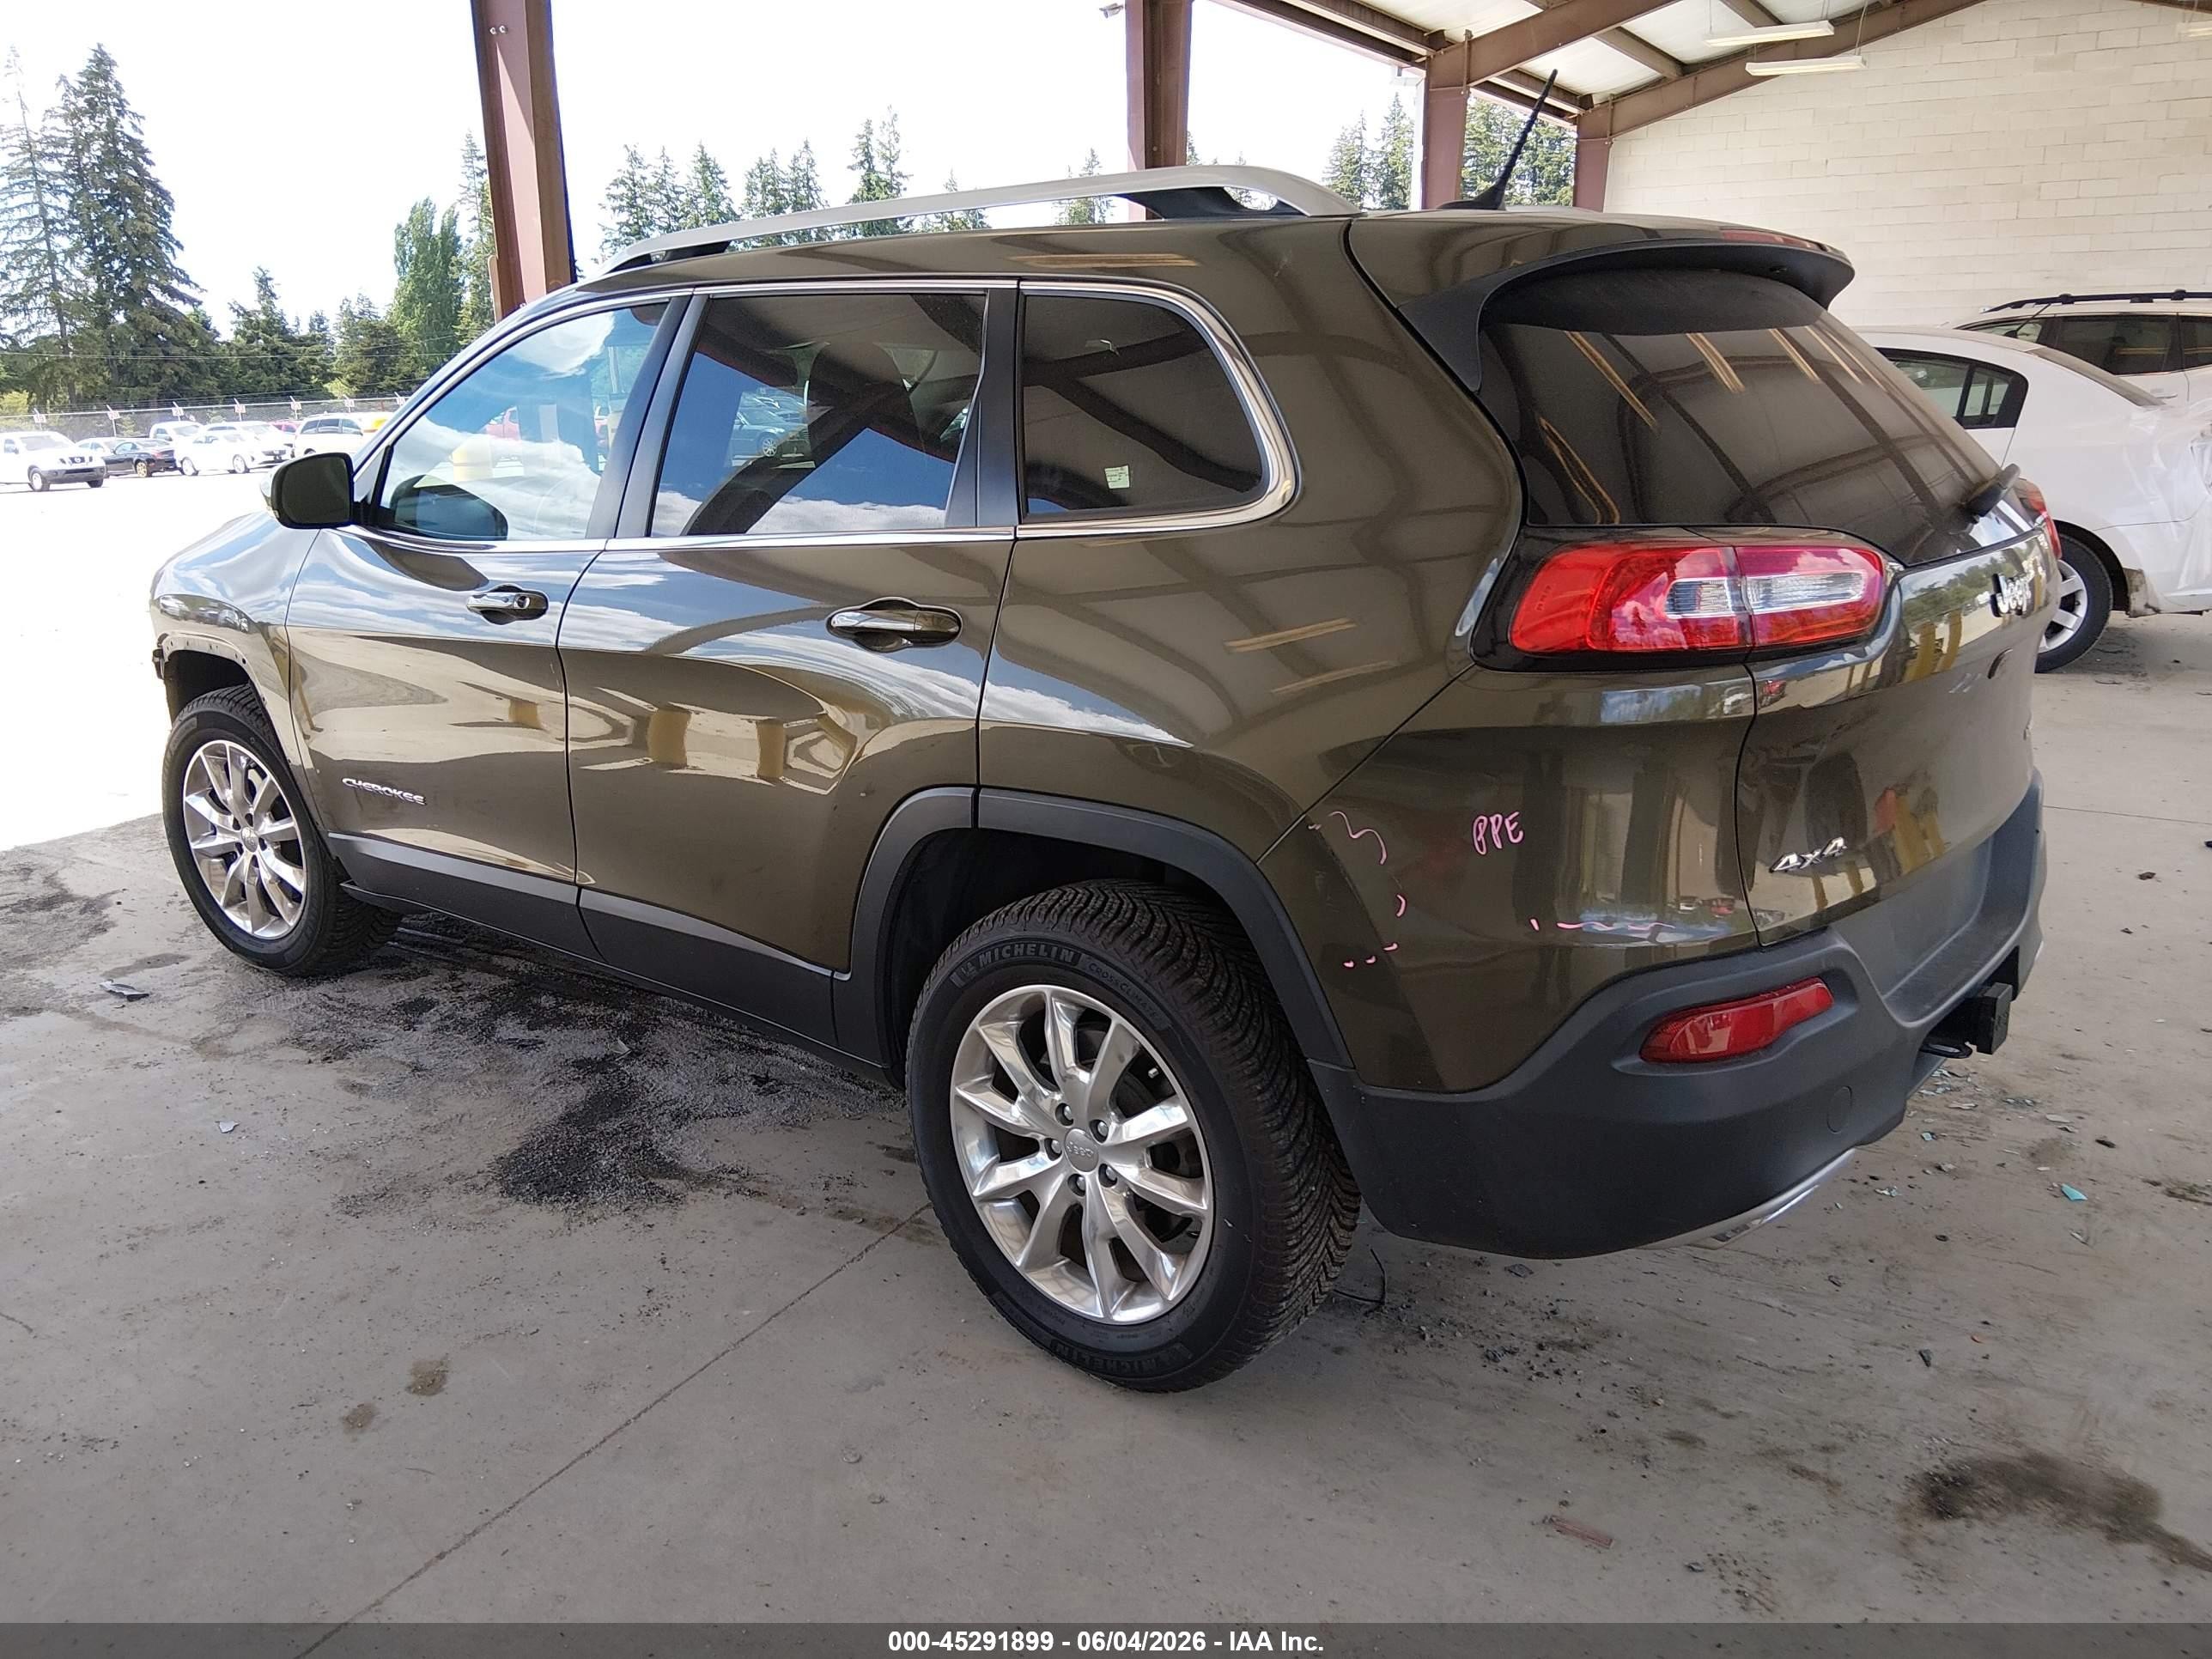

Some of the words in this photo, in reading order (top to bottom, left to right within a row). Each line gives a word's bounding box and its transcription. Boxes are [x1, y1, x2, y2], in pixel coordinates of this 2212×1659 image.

[1991, 574, 2031, 617] Jeep
[342, 777, 428, 805] CHEROKEE
[979, 943, 1073, 969] MICHELIN
